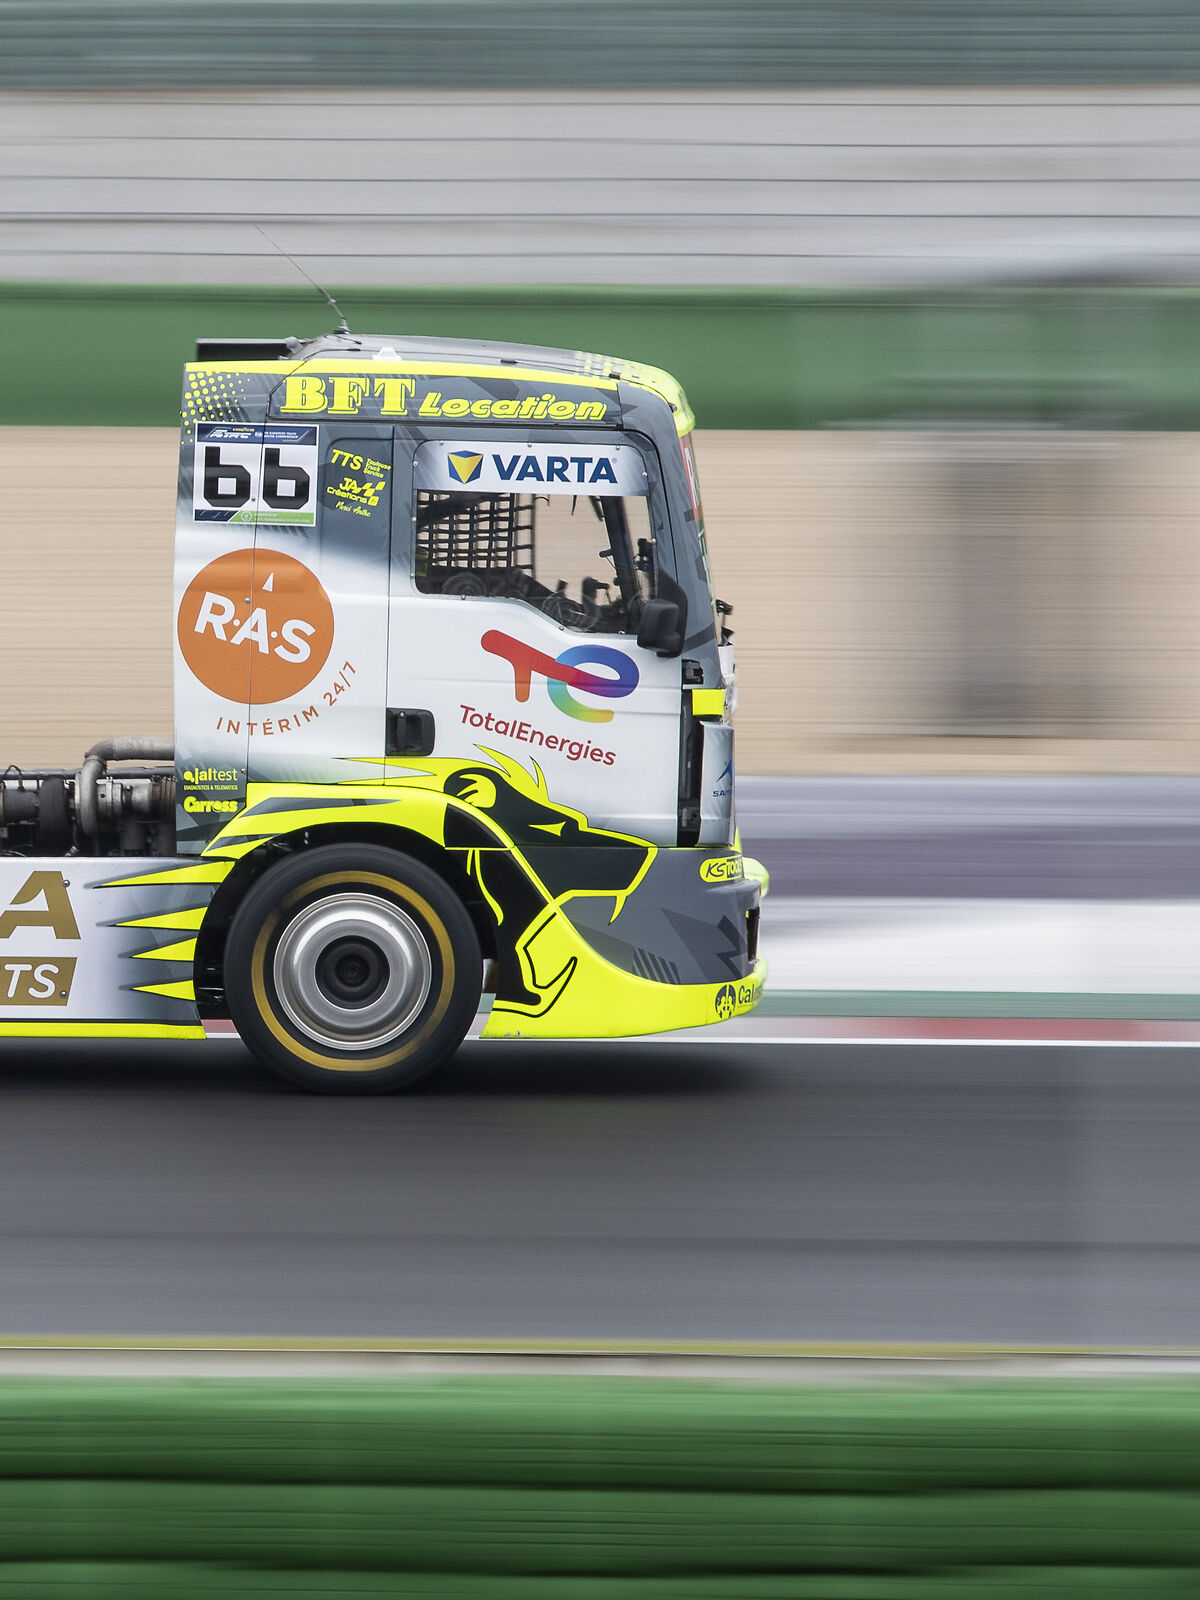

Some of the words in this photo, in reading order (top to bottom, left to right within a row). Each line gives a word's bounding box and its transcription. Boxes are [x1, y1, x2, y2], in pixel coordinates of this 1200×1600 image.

[280, 376, 416, 415] BFT
[418, 393, 607, 420] Location
[204, 446, 310, 510] 66
[331, 449, 364, 470] TTS
[492, 454, 618, 484] VARTA
[216, 705, 319, 736] INTÉRIM
[323, 661, 356, 706] 24/7
[460, 704, 617, 766] TotalEnergies
[706, 862, 726, 878] KS
